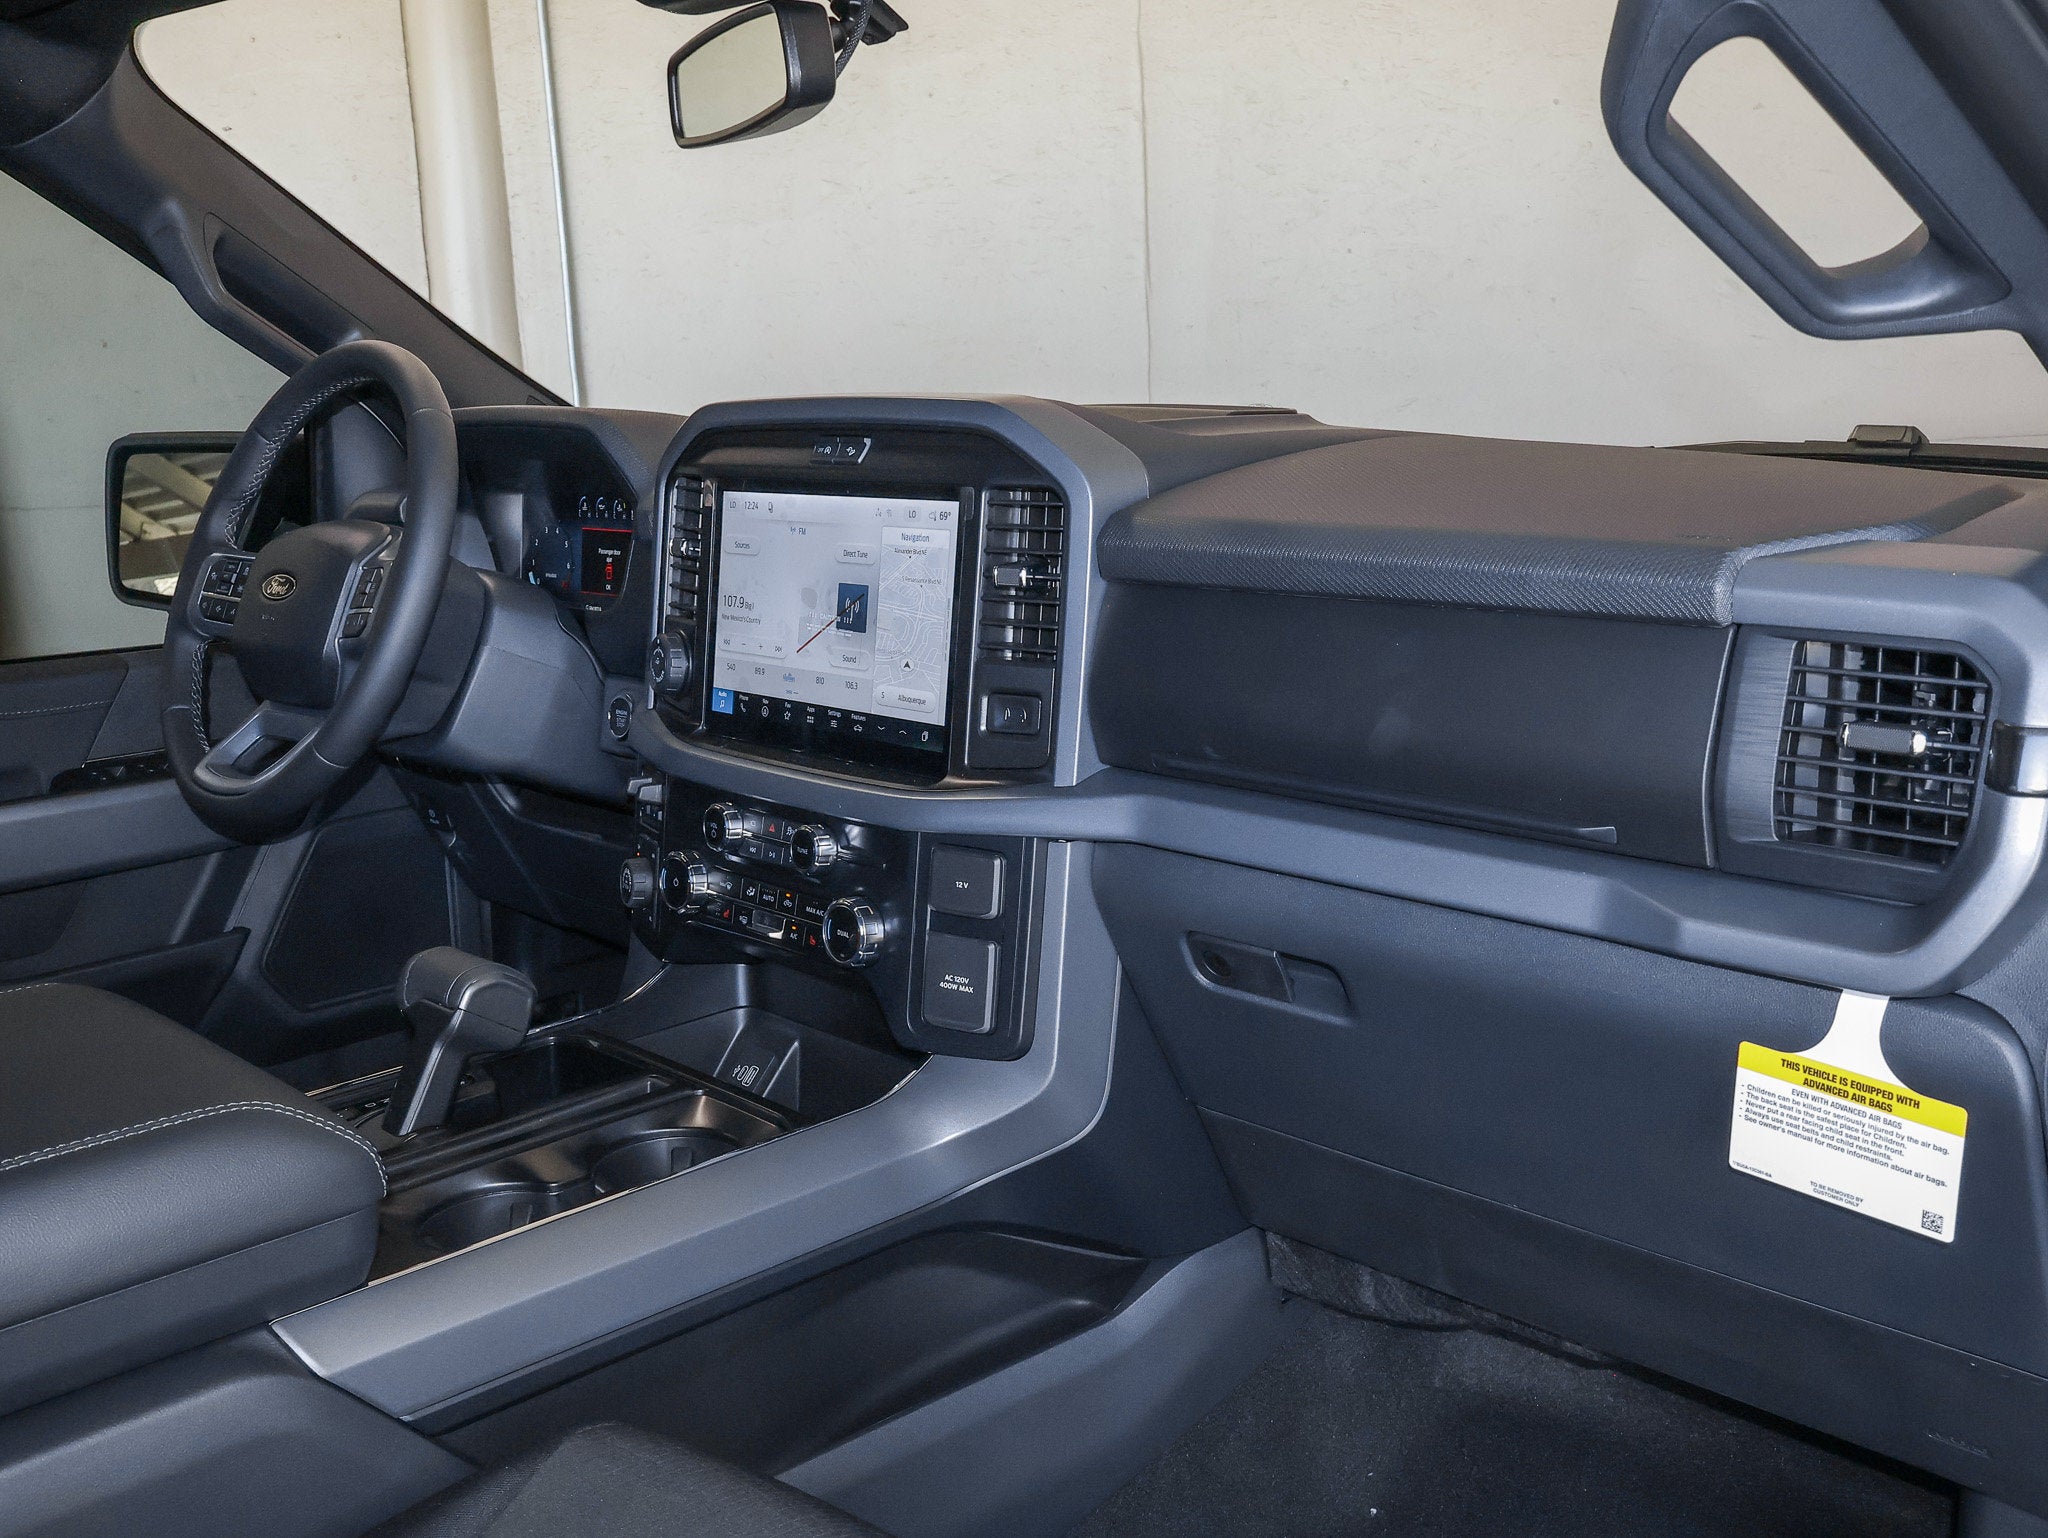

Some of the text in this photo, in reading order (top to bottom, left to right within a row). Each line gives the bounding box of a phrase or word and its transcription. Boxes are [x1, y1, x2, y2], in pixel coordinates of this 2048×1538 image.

[744, 501, 759, 510] 12:24
[908, 510, 917, 519] LO
[901, 532, 930, 543] Navigation
[843, 549, 857, 558] Direct
[266, 576, 289, 595] Ford
[723, 594, 745, 609] 107.9
[842, 654, 857, 663] Sound
[726, 662, 736, 671] 540
[898, 694, 927, 706] Albuquerque
[762, 894, 775, 902] AUTO
[805, 906, 825, 917] MAX A/C
[944, 974, 970, 985] AC 120V
[939, 981, 974, 994] 400W MAX
[1781, 1058, 1801, 1072] THIS
[1802, 1065, 1838, 1084] VEHICLE
[1850, 1079, 1894, 1101] EQUIPPED
[1896, 1094, 1920, 1110] WITH
[1802, 1077, 1893, 1113] ADVANCED AIR BAGS
[1791, 1088, 1902, 1130] EVEN WITH ADVANCED AIR BAGS
[1746, 1083, 1777, 1101] Children
[1802, 1101, 1822, 1113] killed
[1832, 1112, 1866, 1129] seriously
[1867, 1123, 1894, 1137] injured
[1906, 1135, 1920, 1145] the
[1932, 1143, 1950, 1155] bag.
[1746, 1091, 1760, 1101] The
[1760, 1096, 1778, 1107] back
[1778, 1103, 1794, 1112] seat
[1816, 1115, 1838, 1127] safest
[1839, 1123, 1860, 1134] place
[1873, 1132, 1907, 1150] Children.
[1744, 1107, 1770, 1120] Always
[1785, 1121, 1801, 1131] seat
[1801, 1125, 1820, 1137] belts
[1820, 1133, 1835, 1142] and
[1835, 1138, 1855, 1148] child
[1855, 1144, 1893, 1161] restraints.
[1745, 1099, 1766, 1111] Never
[1785, 1113, 1801, 1122] rear
[1801, 1117, 1824, 1131] facing
[1824, 1126, 1843, 1137] child
[1844, 1132, 1861, 1142] seat
[1884, 1144, 1904, 1157] front.
[1744, 1114, 1758, 1124] See
[1786, 1129, 1813, 1143] manual
[1826, 1142, 1845, 1153] more
[1846, 1148, 1889, 1168] information
[1890, 1164, 1913, 1176] about
[1925, 1174, 1948, 1188] bags.
[1827, 1186, 1855, 1200] REMOVED
